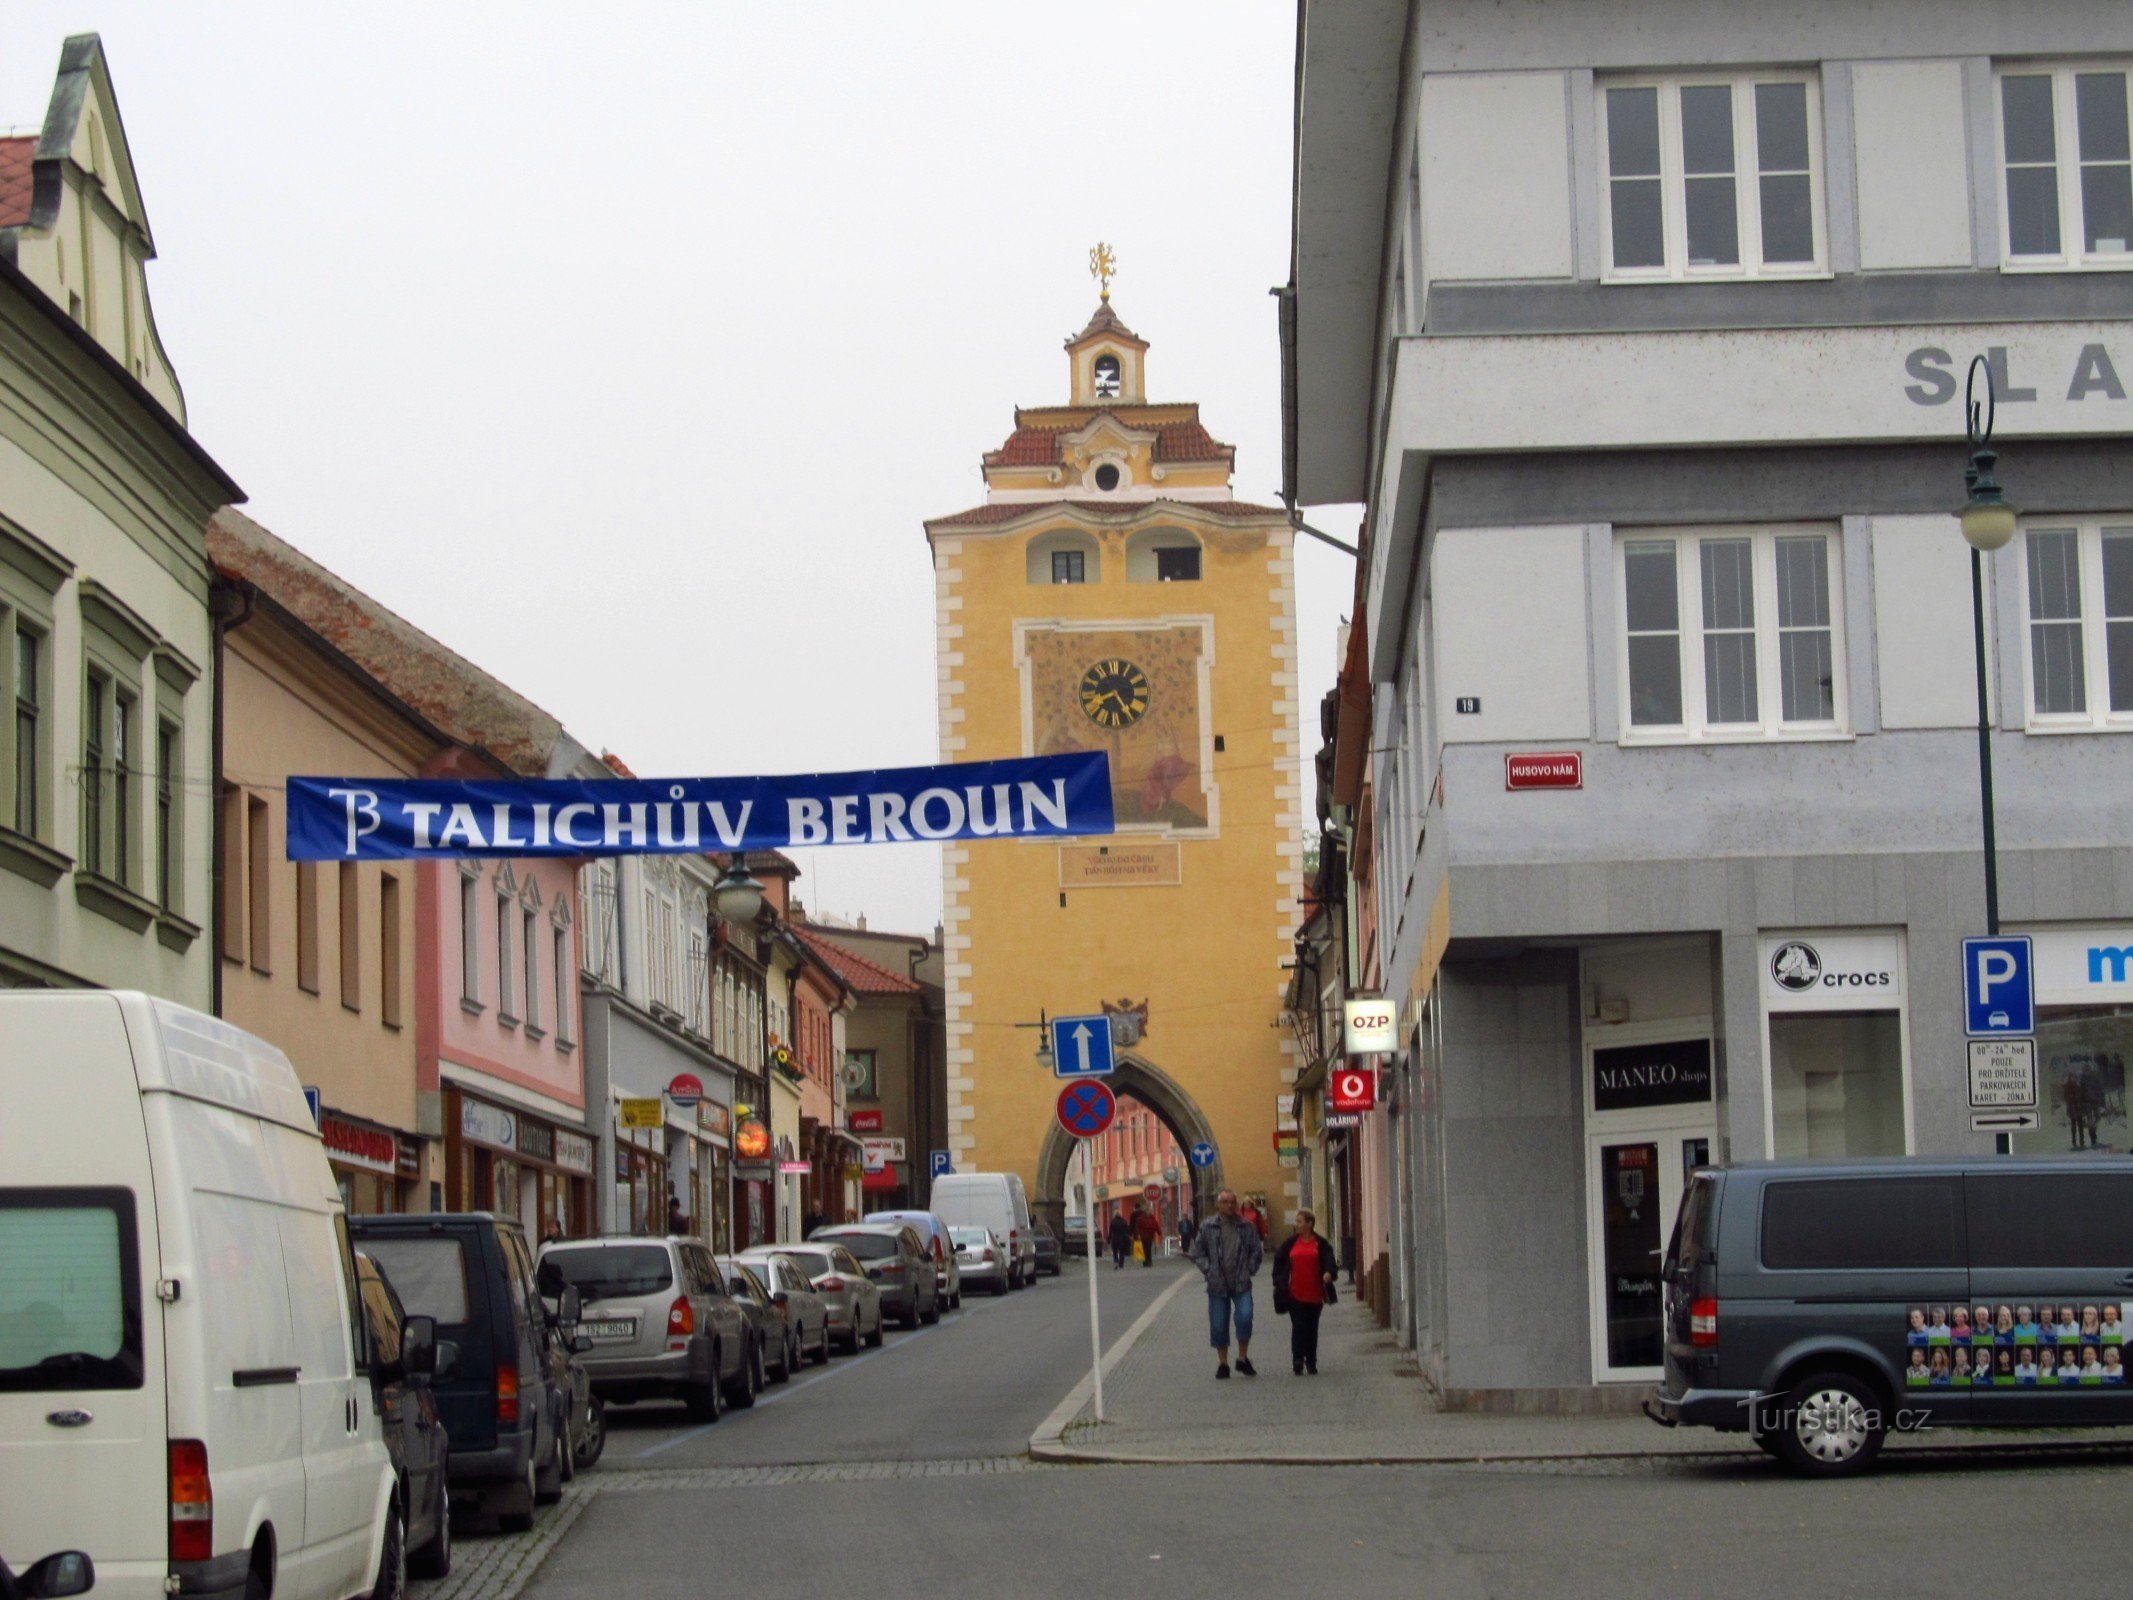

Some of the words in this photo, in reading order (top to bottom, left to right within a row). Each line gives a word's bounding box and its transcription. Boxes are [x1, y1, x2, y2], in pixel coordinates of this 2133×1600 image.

[1462, 700, 1474, 712] 19
[1512, 766, 1551, 776] HUSOVO
[1553, 763, 1576, 776] NÁM.
[401, 784, 753, 849] TALICHŮV
[785, 778, 1068, 846] BEROUN
[1823, 971, 1890, 987] crocs
[1977, 949, 2017, 1005] P
[1353, 1015, 1390, 1028] OZP
[1991, 1057, 2012, 1066] POUZE
[1600, 1063, 1677, 1090] MANEO
[1680, 1070, 1707, 1083] shops
[1979, 1069, 1992, 1078] PRO
[1995, 1067, 2027, 1078] DRŽITELE
[1980, 1080, 2027, 1090] PARKOVACÍCH
[1336, 1098, 1371, 1106] vodafone
[1974, 1092, 1997, 1103] KARET
[2007, 1090, 2025, 1102] ZÓNA
[934, 1153, 947, 1172] P
